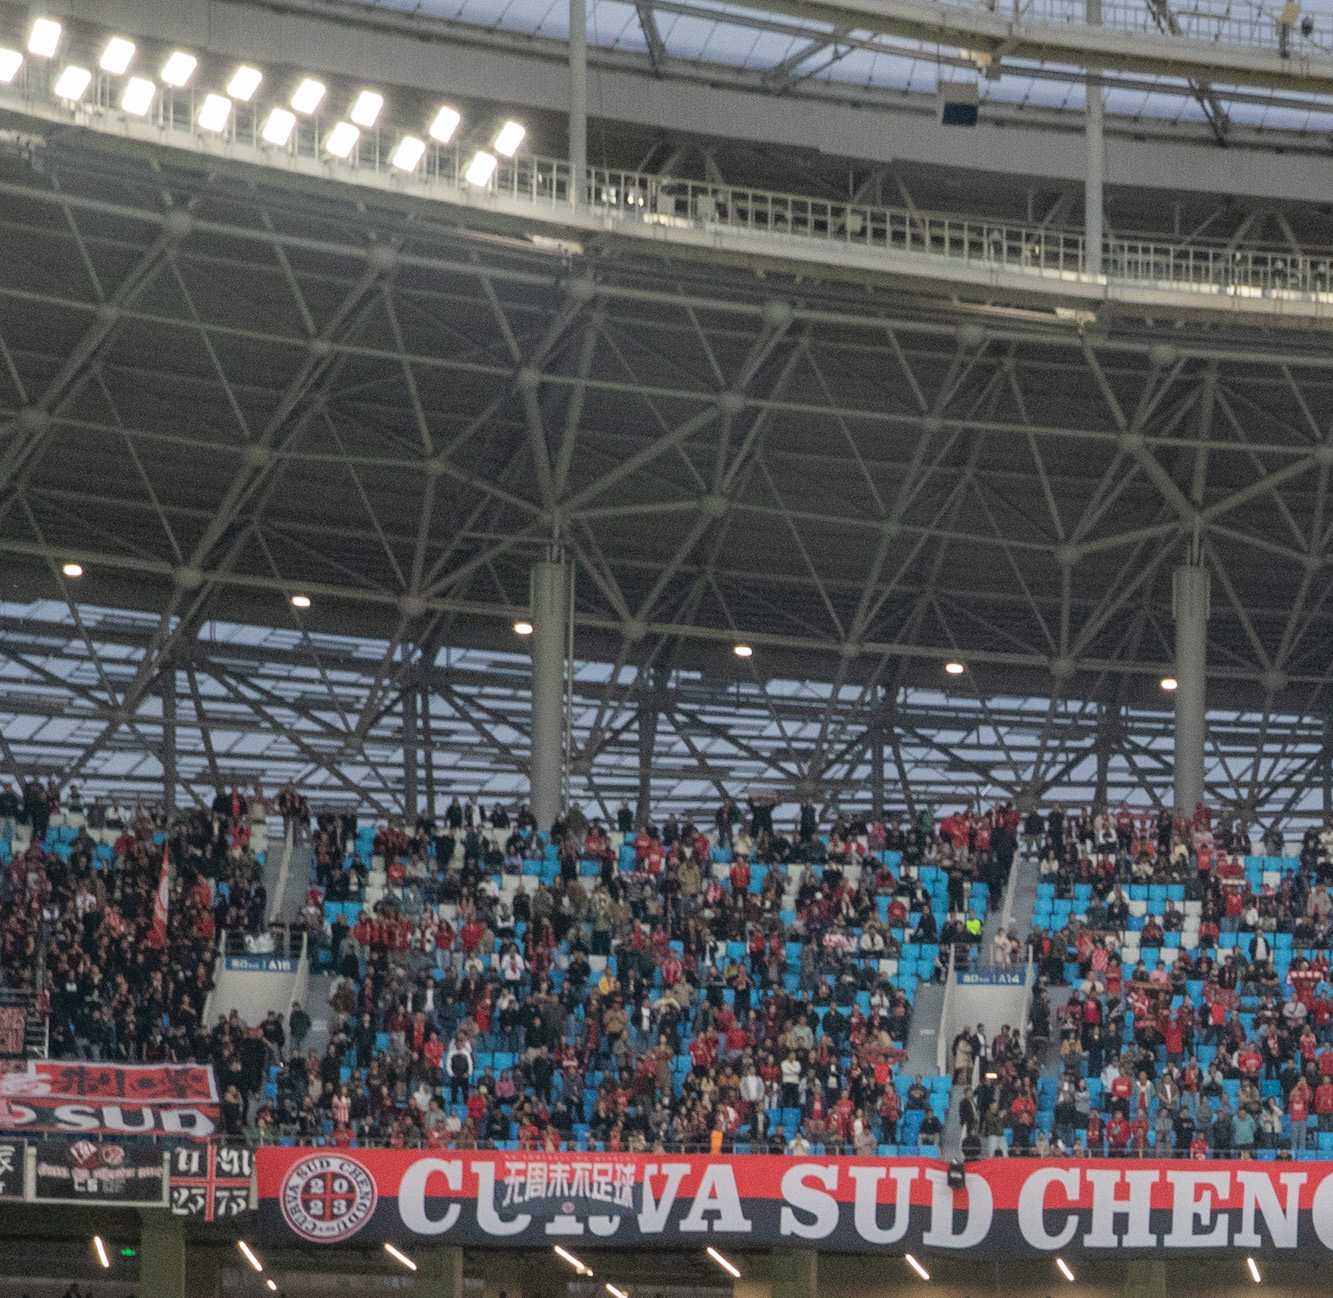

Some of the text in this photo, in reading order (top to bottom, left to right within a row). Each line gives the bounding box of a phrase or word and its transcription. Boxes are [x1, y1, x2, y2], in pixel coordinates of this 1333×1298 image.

[54, 1104, 215, 1138] SUD
[398, 1157, 752, 1236] CUVA
[780, 1164, 993, 1249] SUD
